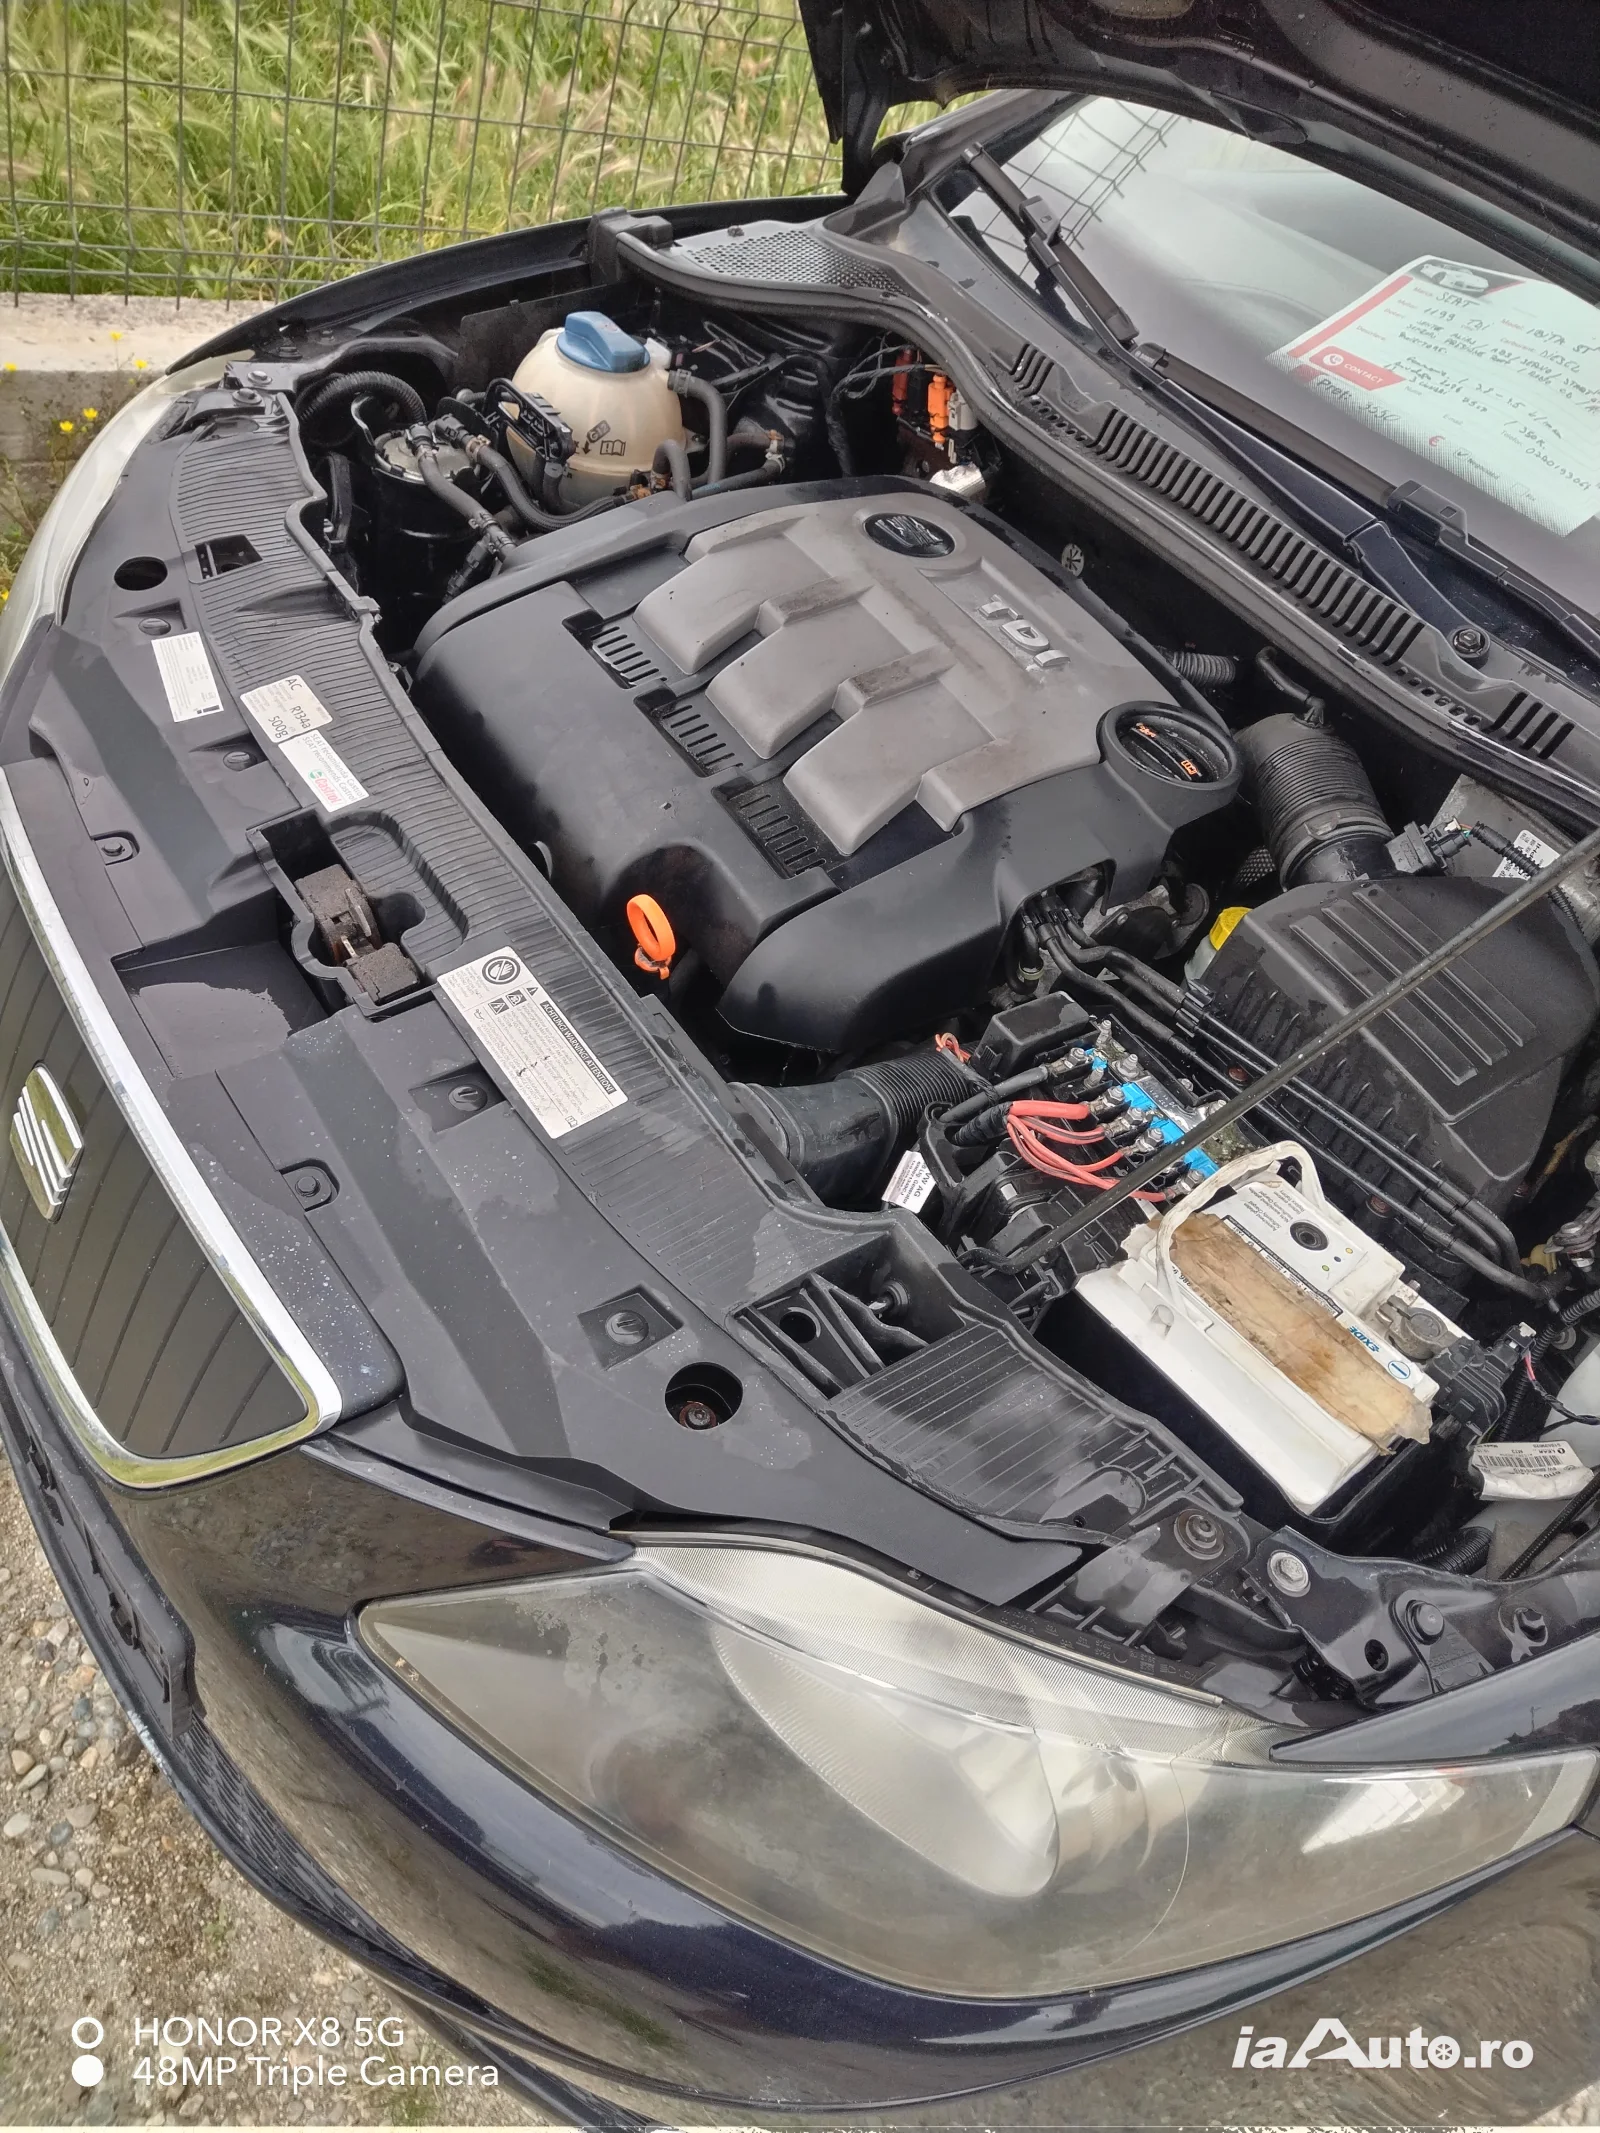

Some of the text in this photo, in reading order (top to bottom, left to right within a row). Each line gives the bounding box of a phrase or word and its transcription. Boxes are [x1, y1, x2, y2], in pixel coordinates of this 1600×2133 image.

[1436, 291, 1480, 308] SEAT
[1344, 363, 1384, 384] CONTACT
[978, 593, 1071, 671] TDI
[286, 678, 303, 691] AC
[267, 716, 288, 738] 500g
[289, 706, 311, 728] R134a
[301, 736, 317, 750] SEAT
[309, 733, 325, 746] SEAT
[313, 776, 342, 805] Castrol
[541, 1002, 569, 1032] ACHTUNG!
[563, 1030, 590, 1060] WARNING!
[584, 1057, 614, 1092] ATTENTION!
[914, 1185, 923, 1197] AG
[1347, 1325, 1381, 1352] EXIDE
